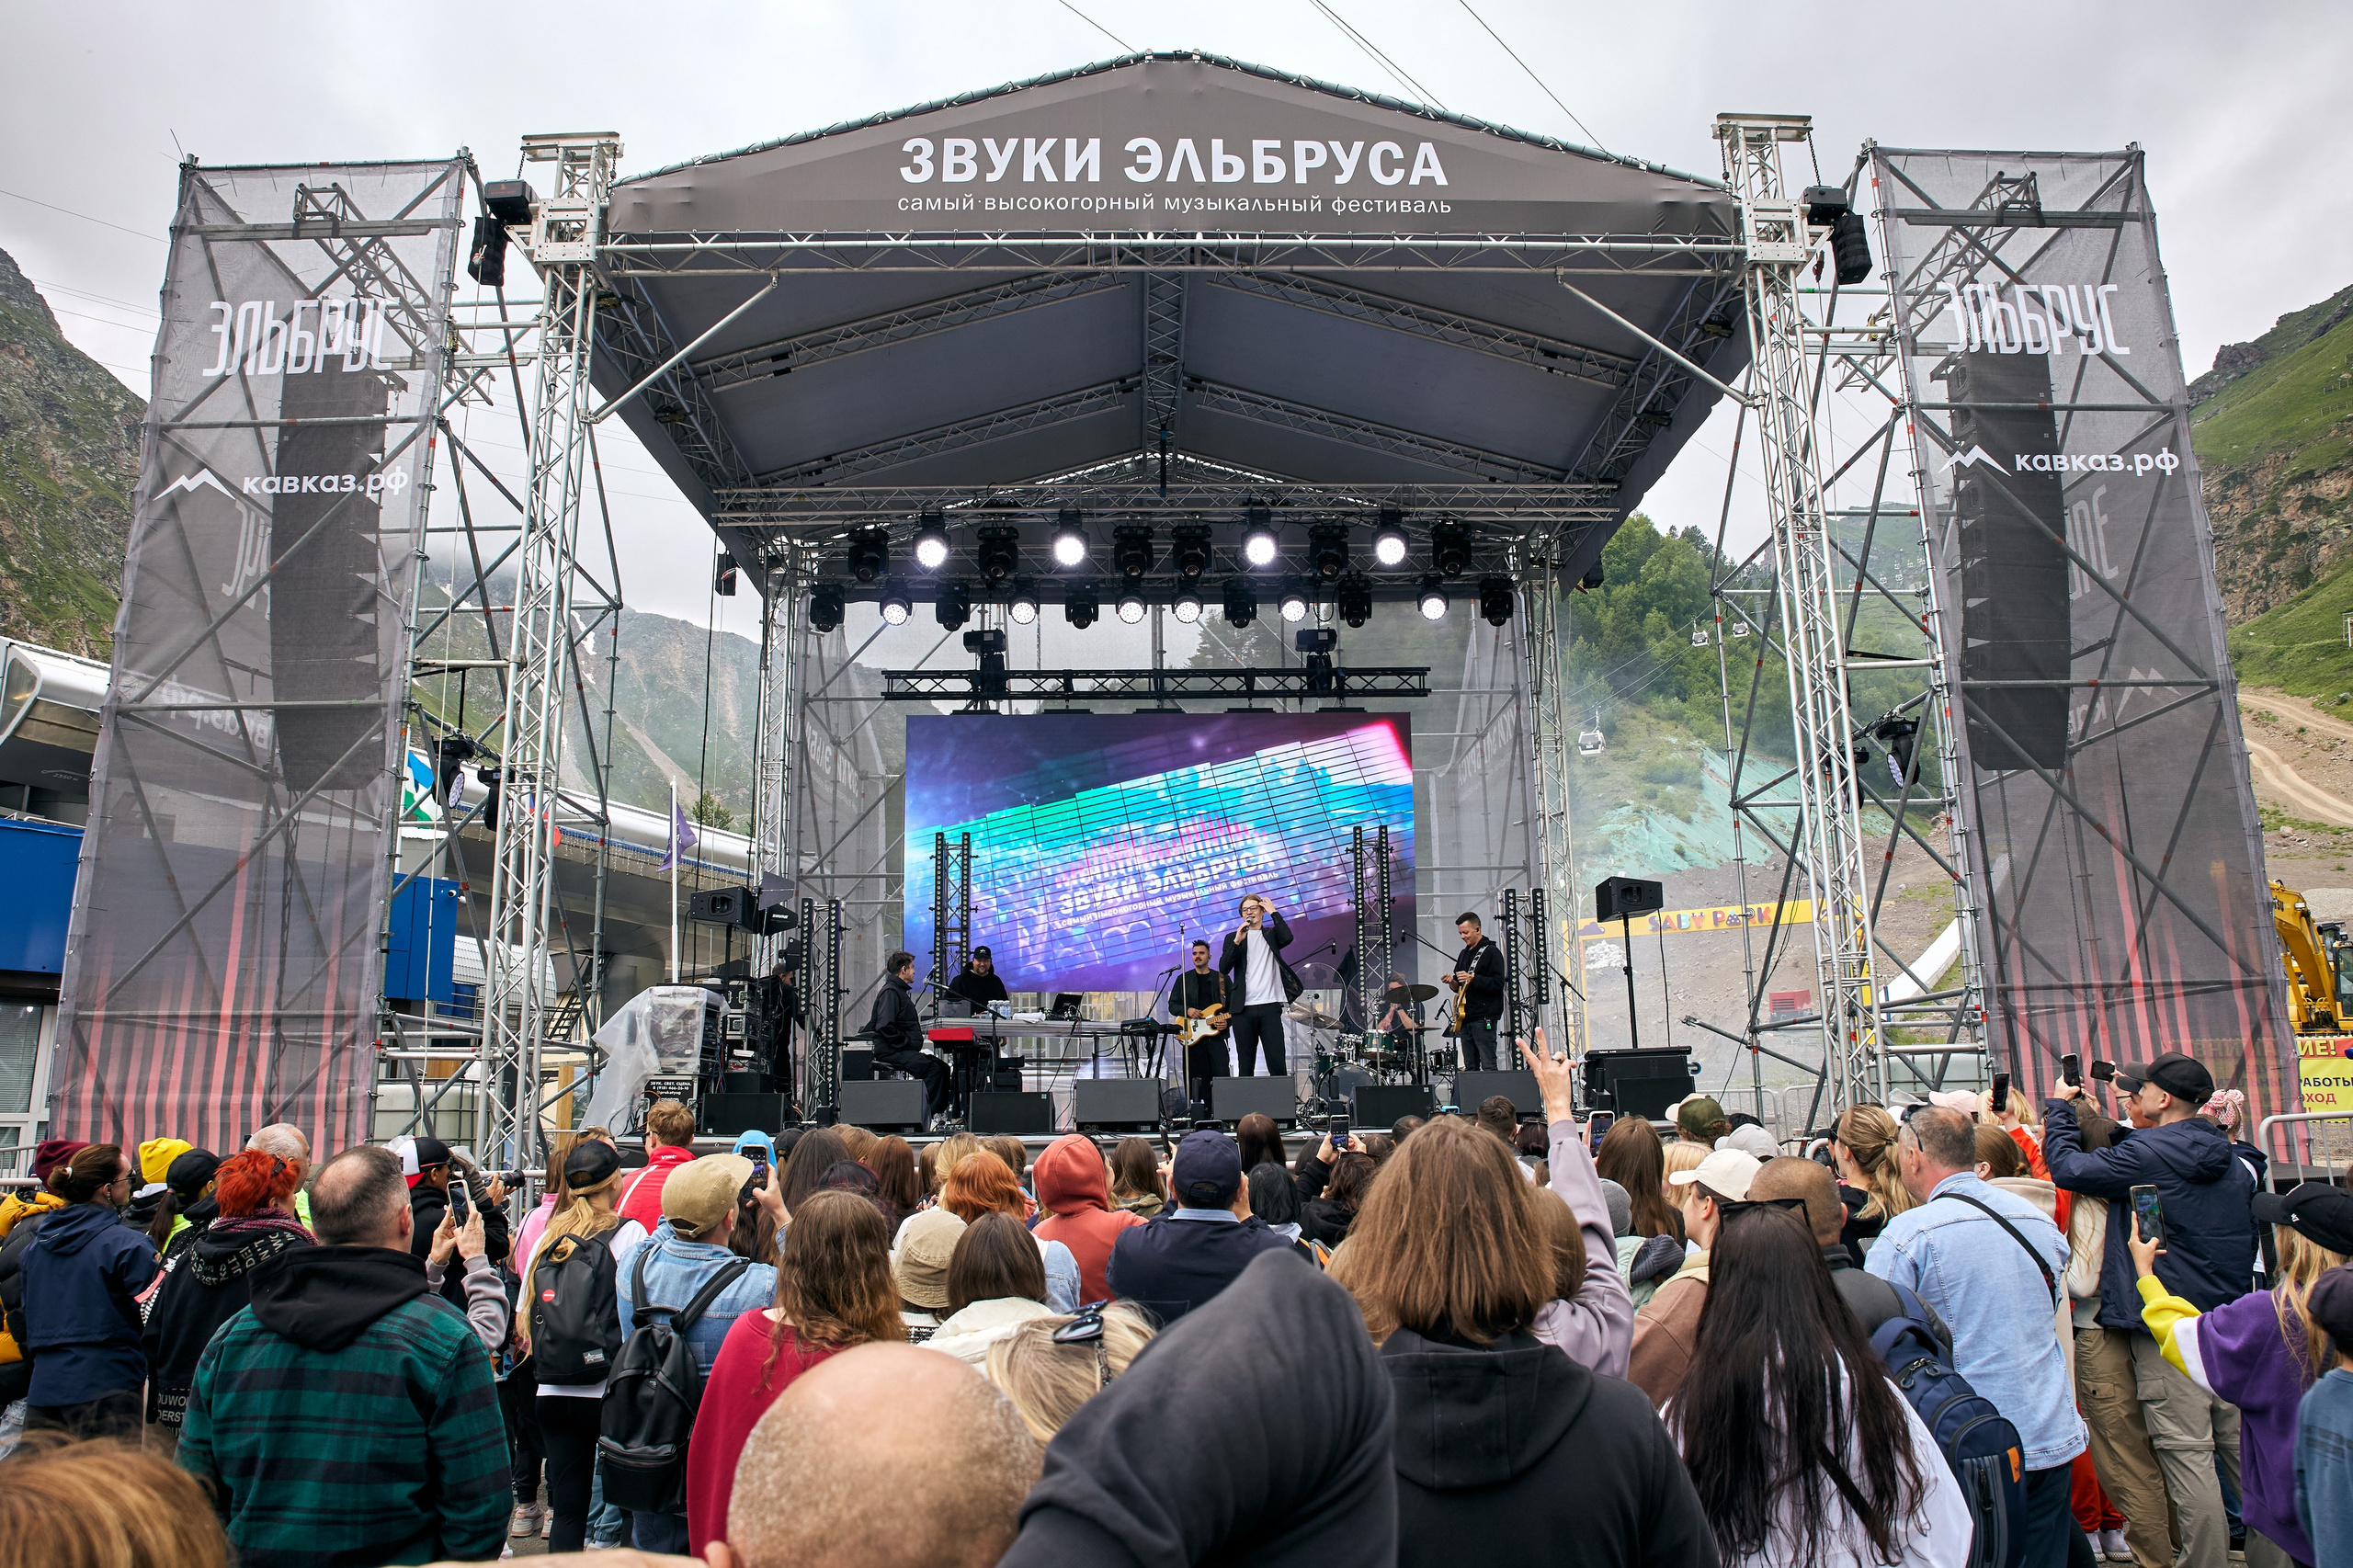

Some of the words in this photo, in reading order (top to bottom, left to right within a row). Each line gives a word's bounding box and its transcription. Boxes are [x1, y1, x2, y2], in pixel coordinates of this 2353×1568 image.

[900, 137, 1100, 183] ЗВУКИ
[1124, 137, 1449, 186] ЭЛЬБРУСА
[897, 193, 974, 210] самый
[983, 193, 1154, 213] высокогорный
[1165, 195, 1322, 214] музыкальный
[1331, 196, 1451, 215] фестиваль
[202, 297, 401, 376] ЭЛЬБРУС
[1936, 281, 2131, 355] ЭЛЬБРУС
[243, 466, 408, 496] кавказ.рф
[2015, 447, 2179, 476] кавказ.рф
[1059, 876, 1140, 915] ЗВУКИ
[1144, 848, 1276, 894] ЭЛЬБРУСА
[1061, 913, 1093, 927] самый
[1093, 898, 1162, 920] высокогорный
[1165, 881, 1228, 903] музыкальный
[1232, 872, 1279, 889] фестиваль
[1648, 912, 1705, 932] SABY
